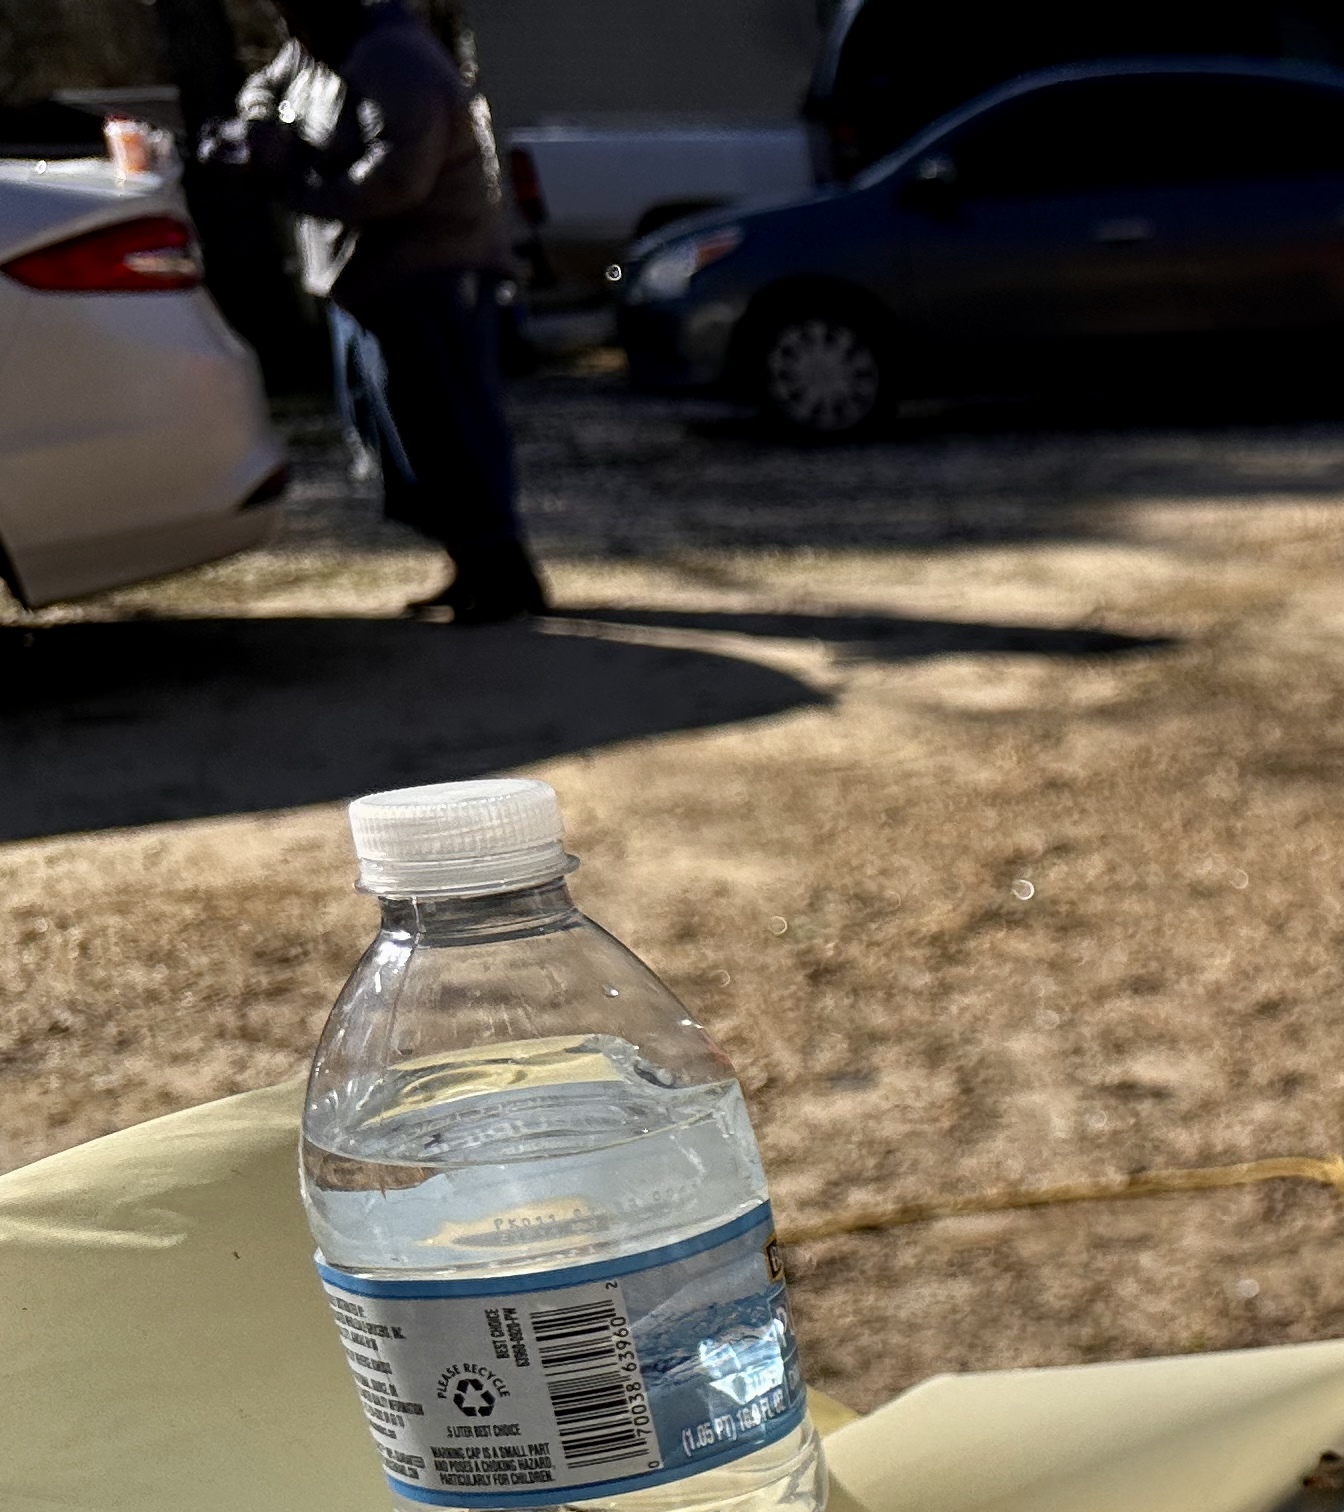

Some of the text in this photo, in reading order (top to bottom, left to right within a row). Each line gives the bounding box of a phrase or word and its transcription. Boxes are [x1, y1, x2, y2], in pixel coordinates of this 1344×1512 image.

[437, 1362, 511, 1400] PLEASE RECYCLE
[605, 1280, 660, 1469] 0 70038 63960 2
[681, 1420, 713, 1458] (1.05
[714, 1414, 737, 1442] PT)
